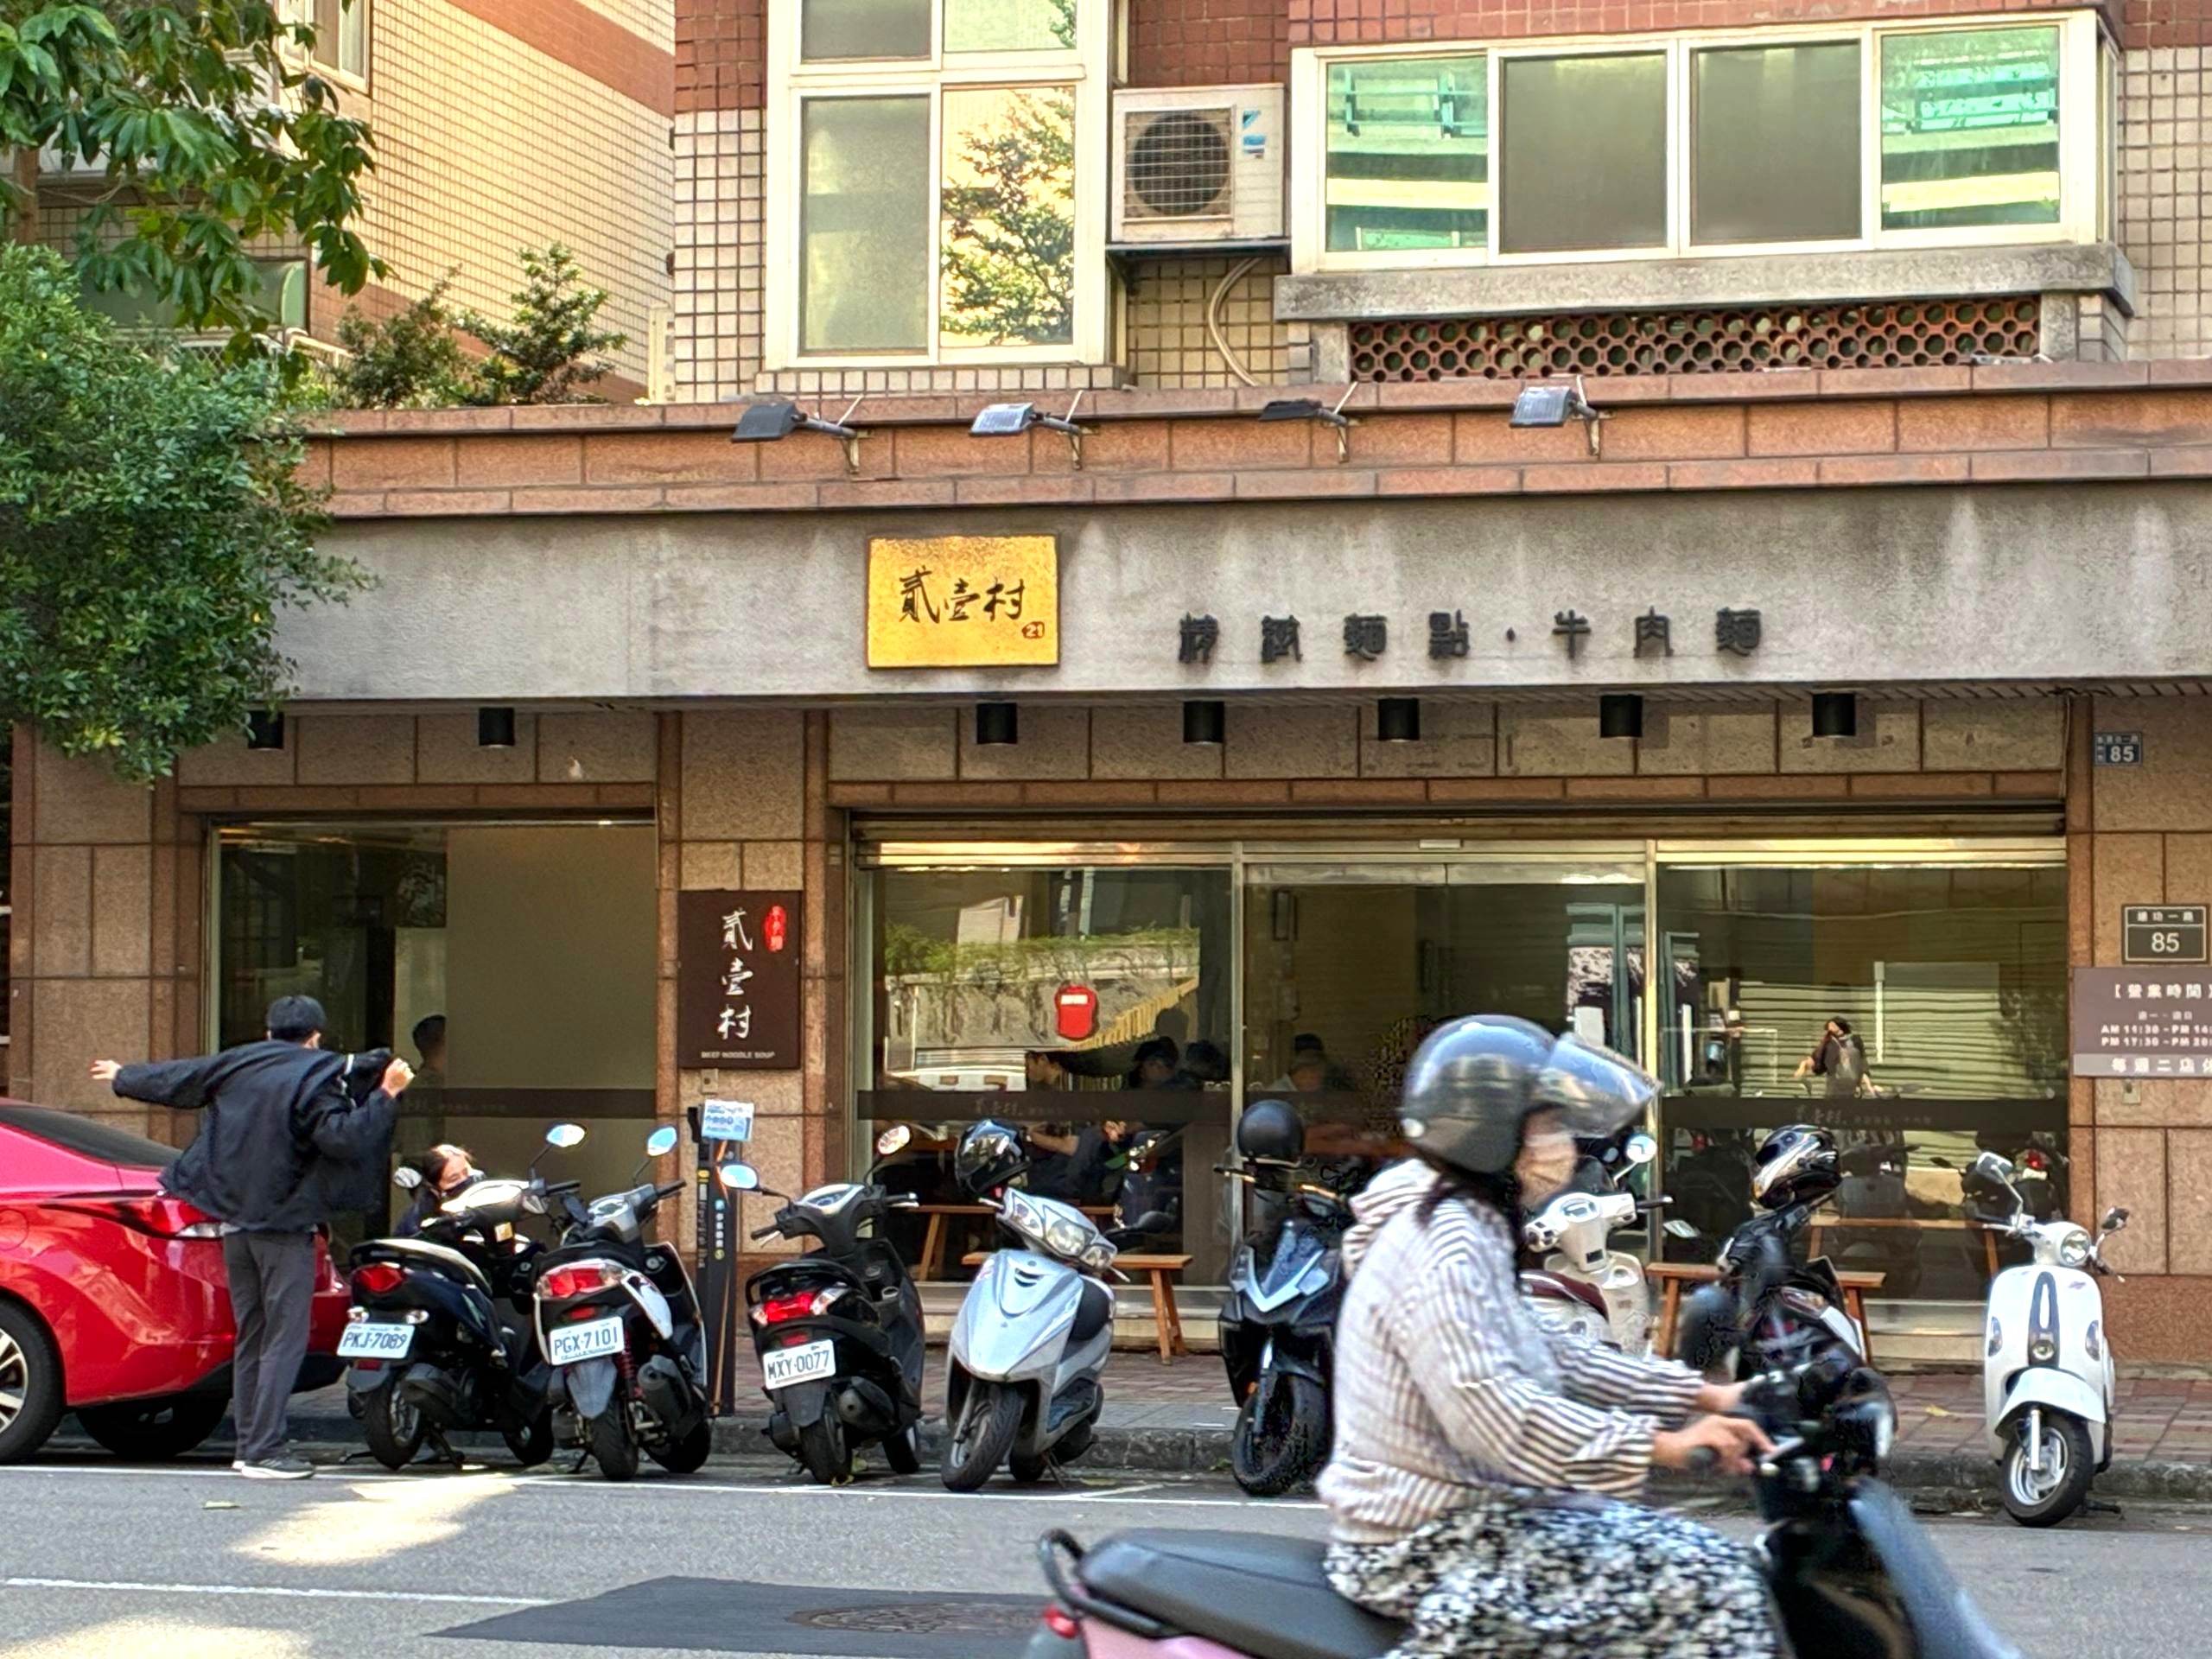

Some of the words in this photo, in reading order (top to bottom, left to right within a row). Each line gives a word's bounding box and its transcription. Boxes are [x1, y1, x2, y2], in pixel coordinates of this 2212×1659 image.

[899, 565, 1026, 623] 貳壹村
[2110, 746, 2134, 762] 85
[2152, 932, 2179, 952] 85
[717, 907, 753, 1039] 貳壹村
